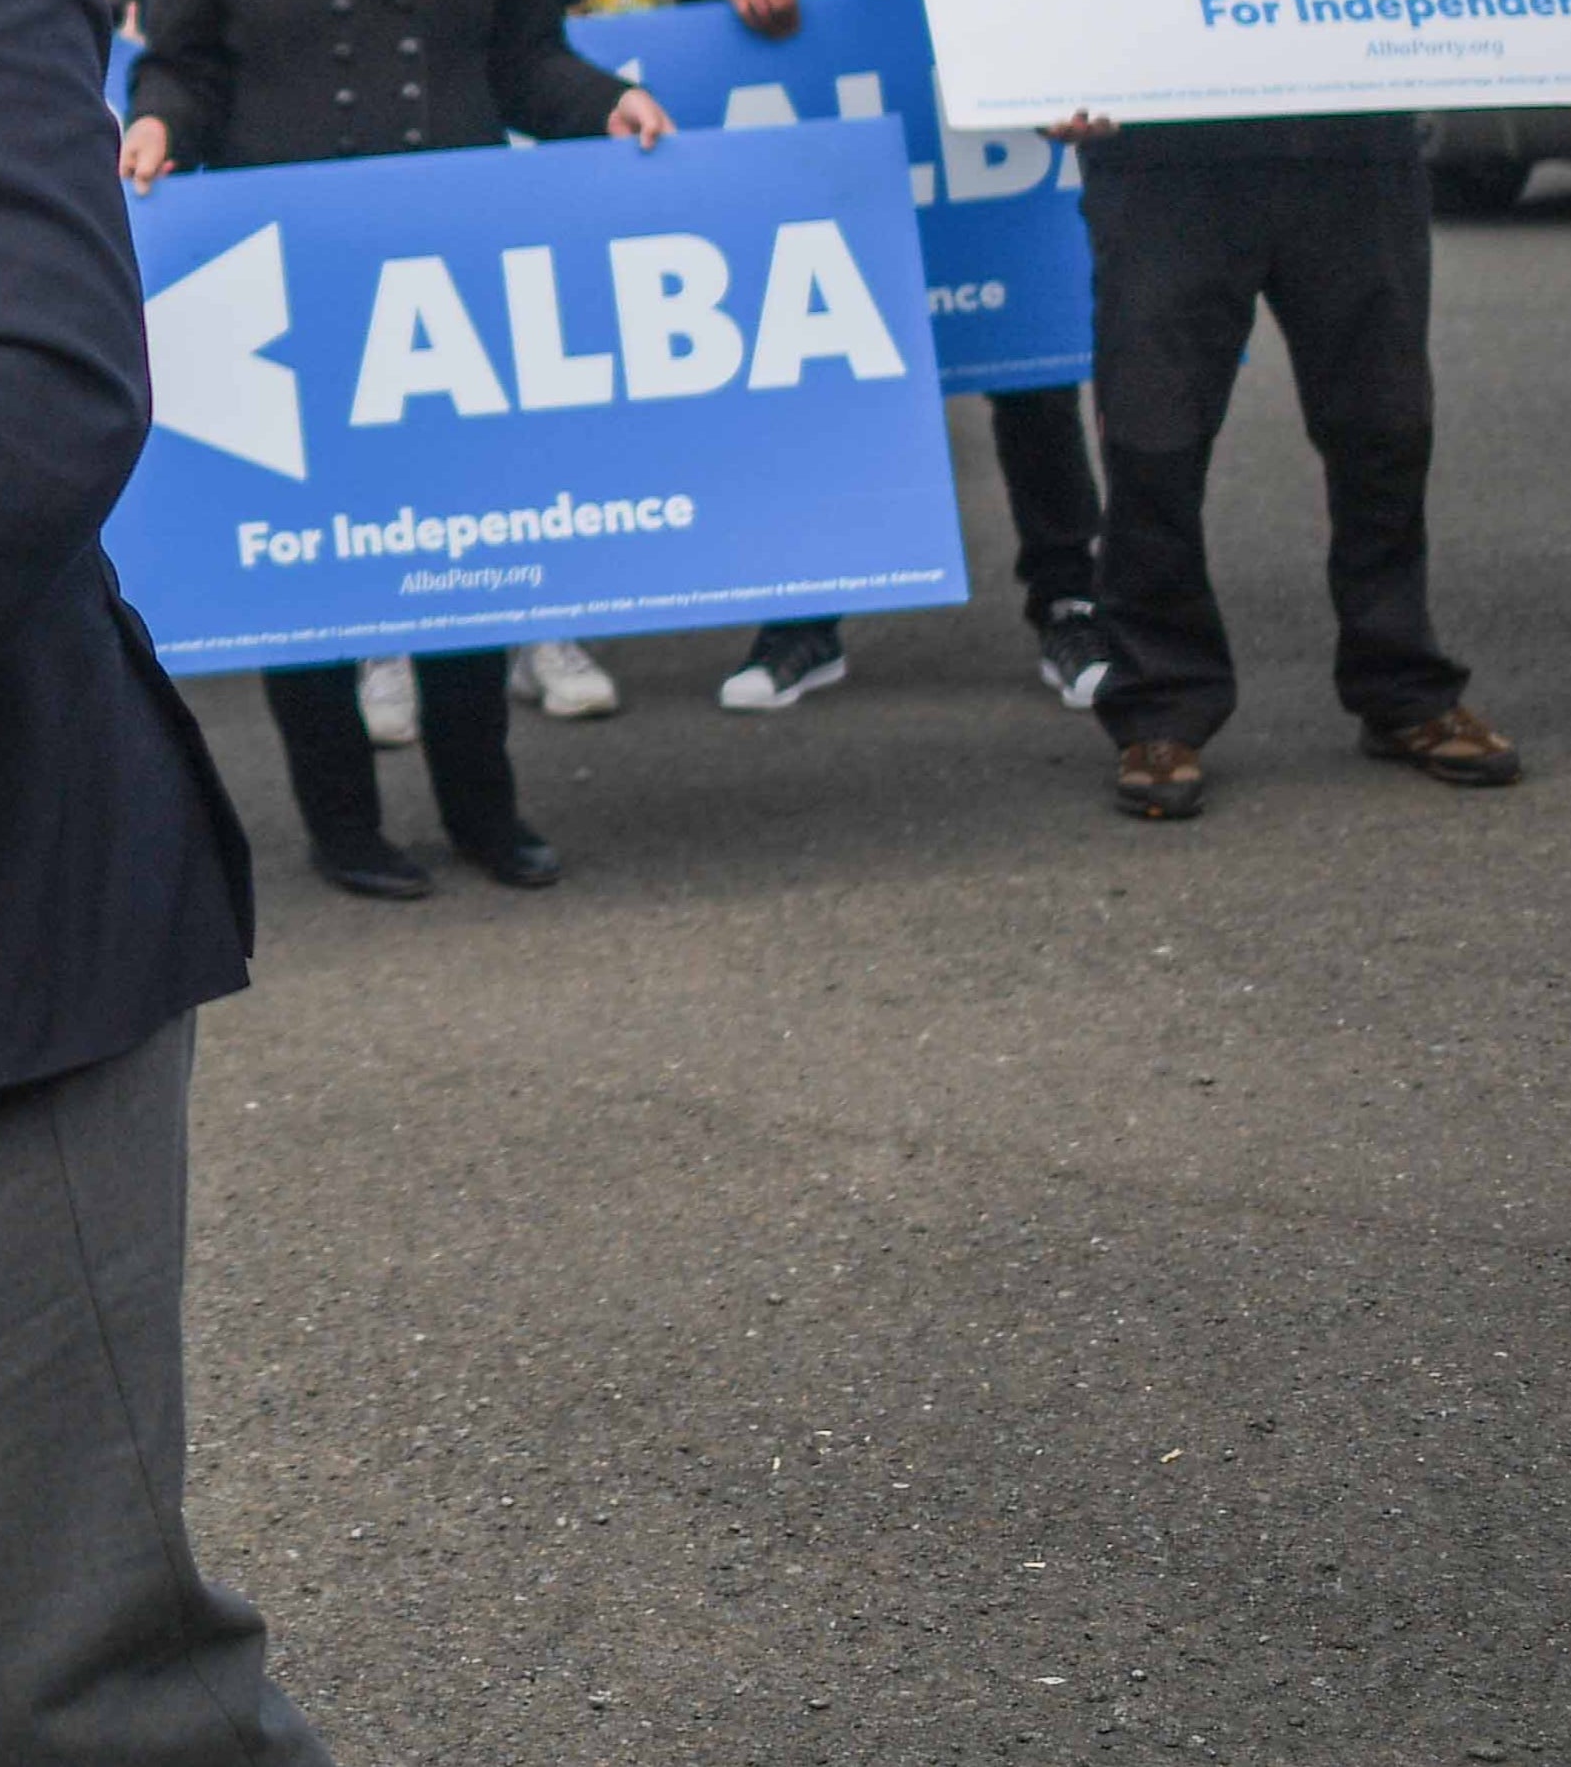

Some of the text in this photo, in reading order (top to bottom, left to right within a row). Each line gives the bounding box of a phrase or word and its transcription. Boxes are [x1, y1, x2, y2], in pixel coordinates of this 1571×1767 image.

[1366, 37, 1505, 62] AlbaParty.org
[349, 219, 907, 427] ALBA
[238, 491, 696, 568] For Independence
[398, 564, 544, 597] AlbaParty.org
